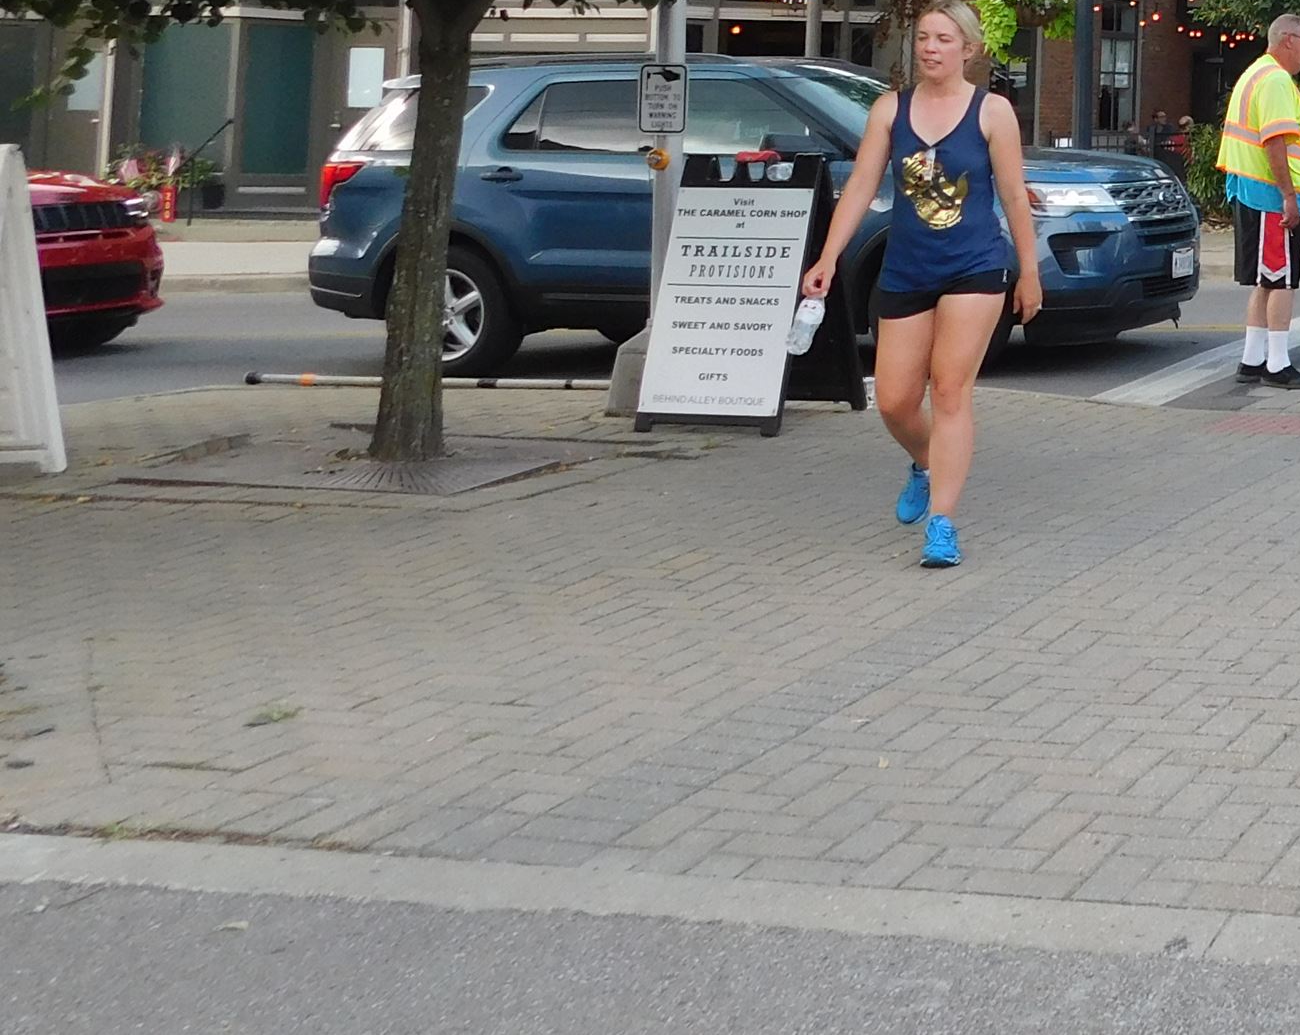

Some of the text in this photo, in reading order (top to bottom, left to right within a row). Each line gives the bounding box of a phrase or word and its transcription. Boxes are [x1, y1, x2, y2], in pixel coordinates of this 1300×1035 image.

[733, 198, 755, 206] Visit
[677, 208, 697, 217] THE
[699, 209, 746, 217] CARAMEL
[780, 210, 807, 218] SHOP
[681, 244, 791, 258] TRAILSIDE
[689, 264, 775, 279] PROVISIONS
[674, 295, 780, 306] TREATS AND SNACKS
[671, 321, 773, 331] SWEET AND SAVORY
[671, 346, 764, 357] SPECIALTY FOODS
[698, 372, 729, 381] GIFTS
[652, 394, 765, 406] BEHIND ALLEY BOUTIQUE
